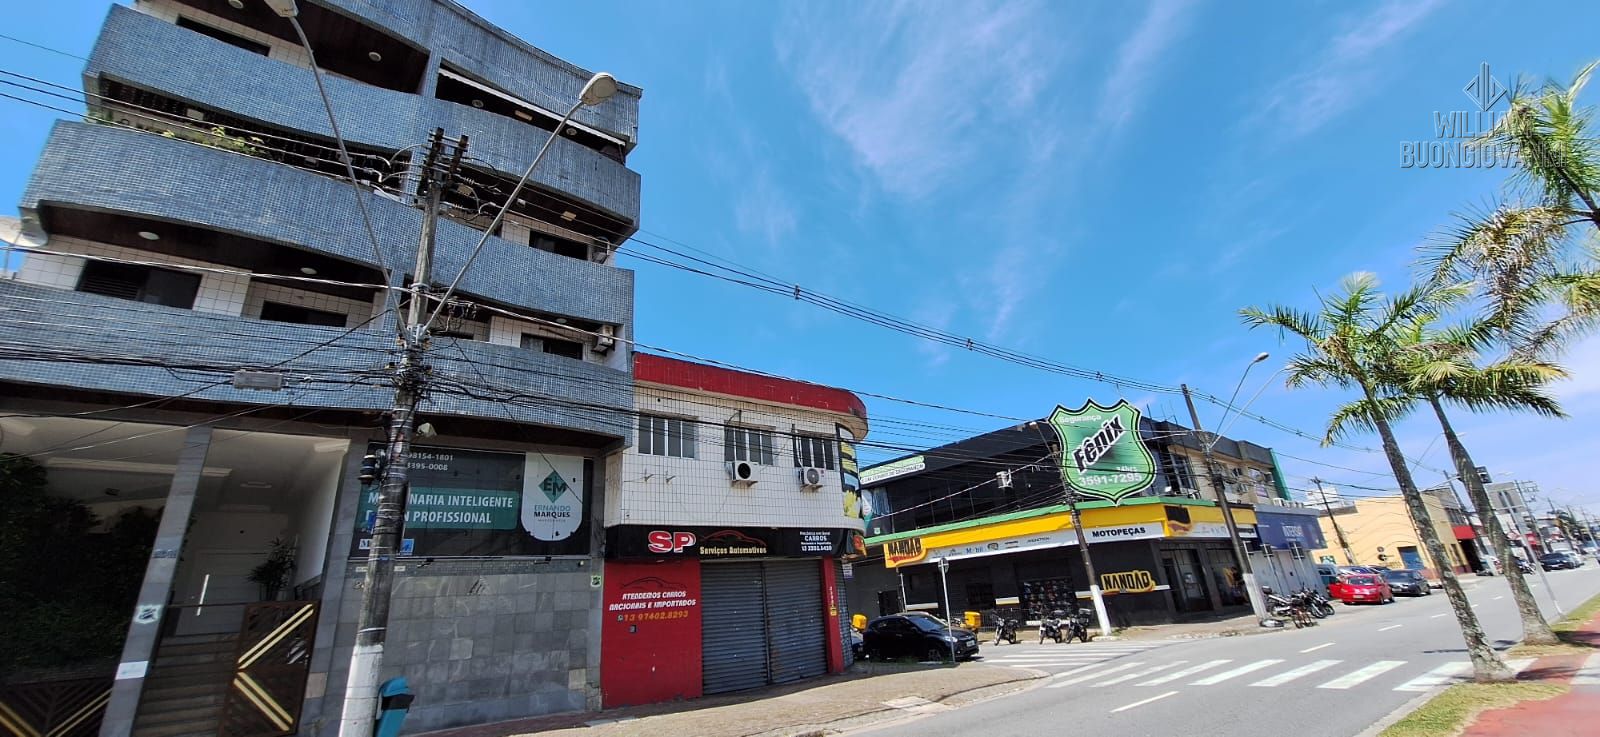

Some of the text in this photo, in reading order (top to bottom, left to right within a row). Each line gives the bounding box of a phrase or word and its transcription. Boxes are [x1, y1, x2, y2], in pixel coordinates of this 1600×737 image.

[1059, 414, 1101, 424] Segurança
[1073, 414, 1126, 474] Fênix
[1079, 472, 1142, 486] 3591-7295
[448, 494, 513, 508] INTELIGENTE
[413, 511, 492, 523] PROFISSIONAL
[534, 511, 571, 519] MARQUES
[1092, 527, 1146, 537] MOTOPEÇAS
[647, 530, 697, 553] SP
[700, 546, 767, 556] Serviços Automotivos
[622, 591, 687, 600] ATENDEMOS CARROS
[609, 602, 647, 611] NACIONAIS
[653, 599, 697, 608] IMPORTADOS
